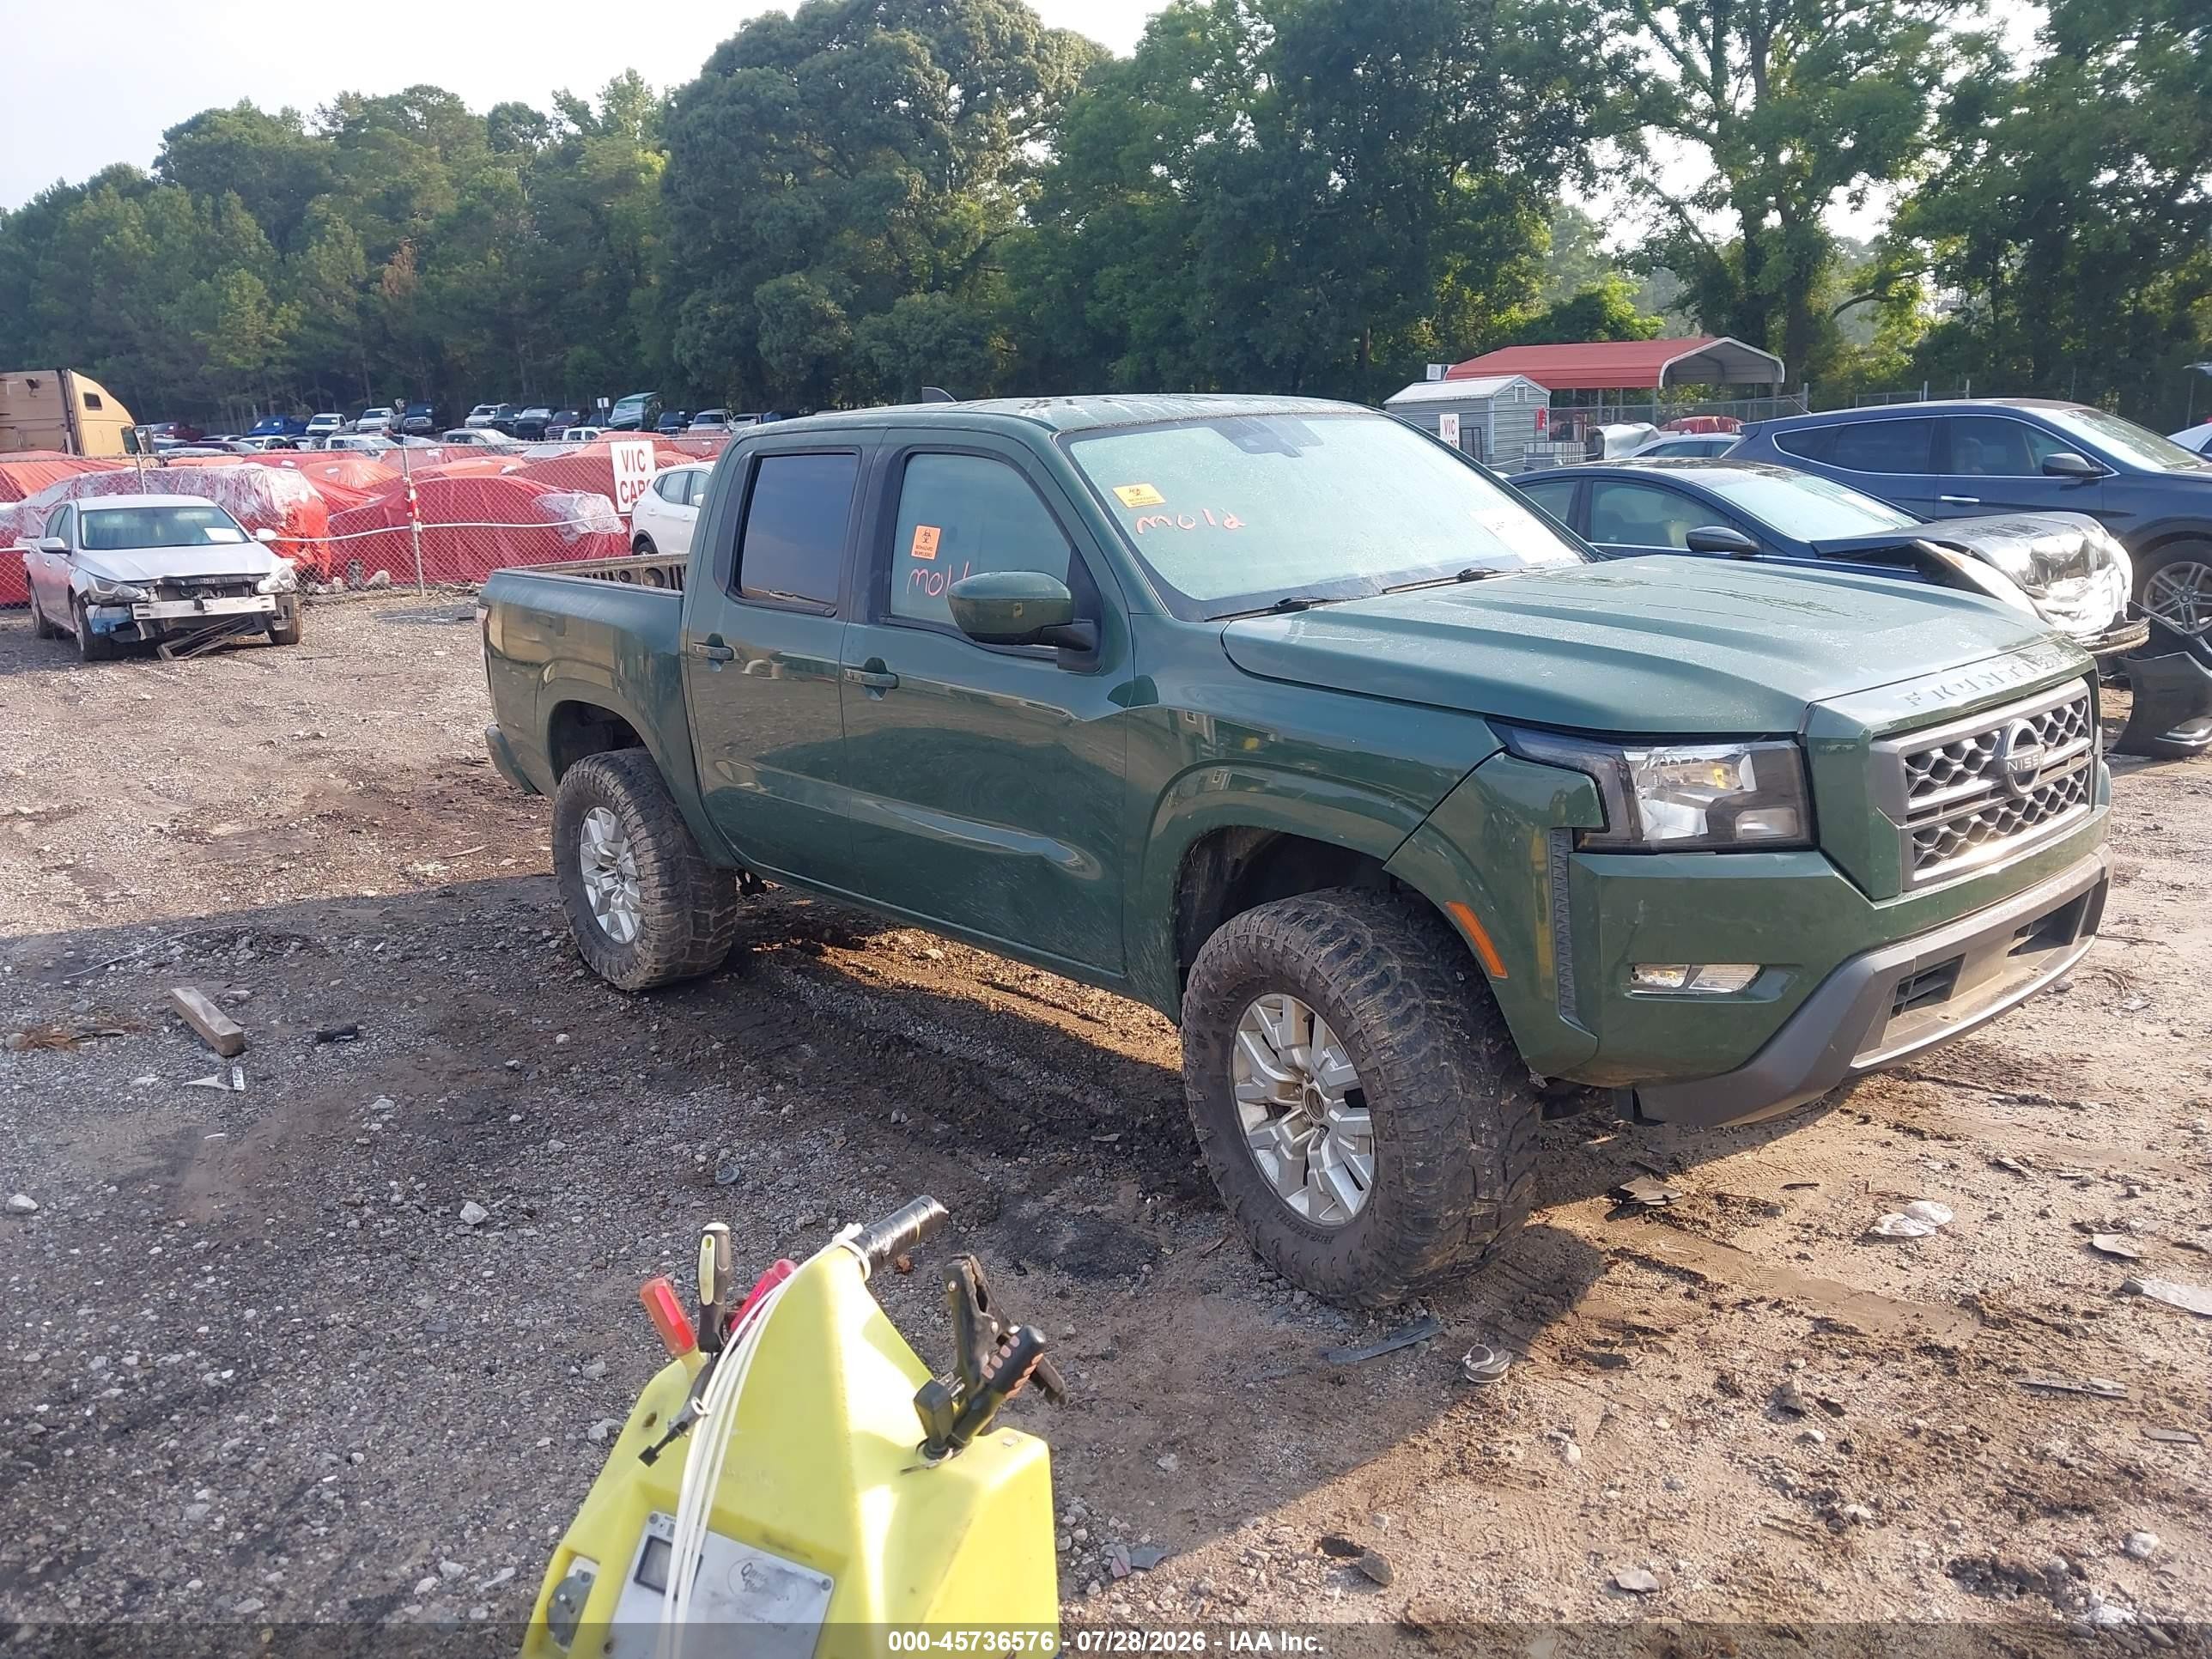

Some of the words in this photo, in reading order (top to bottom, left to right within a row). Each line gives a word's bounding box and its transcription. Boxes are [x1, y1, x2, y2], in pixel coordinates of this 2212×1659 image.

[1443, 418, 1455, 435] VIC
[621, 448, 647, 473] VIC
[619, 478, 651, 505] CAR
[1134, 507, 1247, 535] mold
